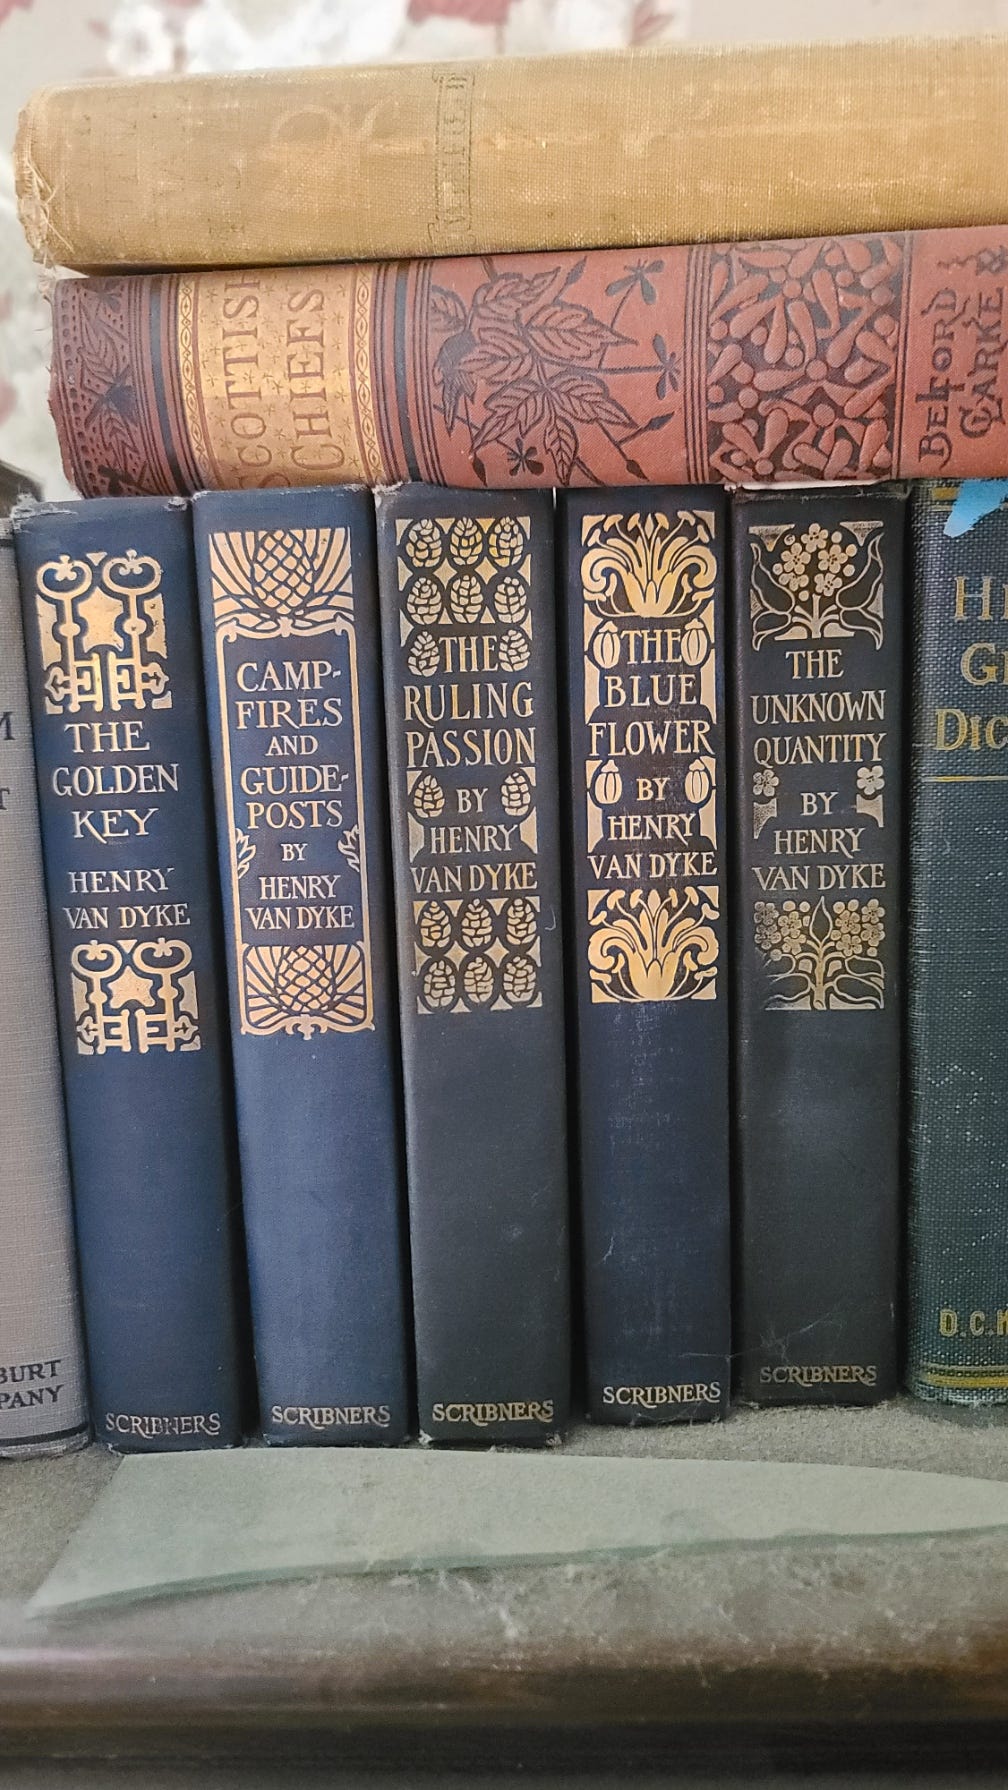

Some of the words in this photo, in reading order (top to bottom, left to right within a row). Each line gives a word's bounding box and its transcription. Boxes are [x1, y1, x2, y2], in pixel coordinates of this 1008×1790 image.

[286, 288, 346, 471] CHIEFS
[438, 635, 499, 673] THE
[621, 628, 682, 664] THE
[237, 660, 341, 692] CAMP-
[785, 648, 844, 680] THE
[404, 681, 534, 728] RULING
[604, 674, 697, 708] BLUE
[236, 699, 343, 730] FIRES
[750, 689, 886, 726] UNKNOWN
[64, 721, 150, 753] THE
[265, 736, 318, 757] AND
[405, 727, 536, 768] PASSION
[588, 720, 715, 756] FLOWER
[753, 732, 887, 769] QUANTITY
[52, 764, 179, 796] GOLDEN
[241, 765, 349, 796] GUIDE-
[636, 777, 670, 801] BY
[247, 801, 343, 829] POSTS
[456, 788, 488, 813] BY
[801, 791, 838, 816] BY
[71, 808, 160, 844] KEY
[430, 823, 519, 854] HENRY
[607, 813, 697, 845] HENRY
[281, 843, 308, 862] BY
[774, 827, 866, 859] HENRY
[68, 867, 175, 894] HENRY
[410, 865, 462, 893] VAN
[469, 862, 537, 891] DYKE
[587, 853, 643, 880] VAN
[649, 851, 718, 878] DYKE
[752, 866, 809, 892] VAN
[817, 863, 887, 891] DYKE
[259, 875, 341, 900] HENRY
[63, 906, 113, 930] VAN
[119, 904, 191, 928] DYKE
[246, 907, 293, 931] VAN
[296, 905, 355, 930] DYKE
[760, 1365, 877, 1388] SCRIBNERS
[602, 1381, 721, 1409] SCRIBNERS
[105, 1412, 221, 1440] SCRIBNERS
[271, 1405, 391, 1430] SCRIBNERS
[432, 1400, 554, 1427] SCRIBNERS
